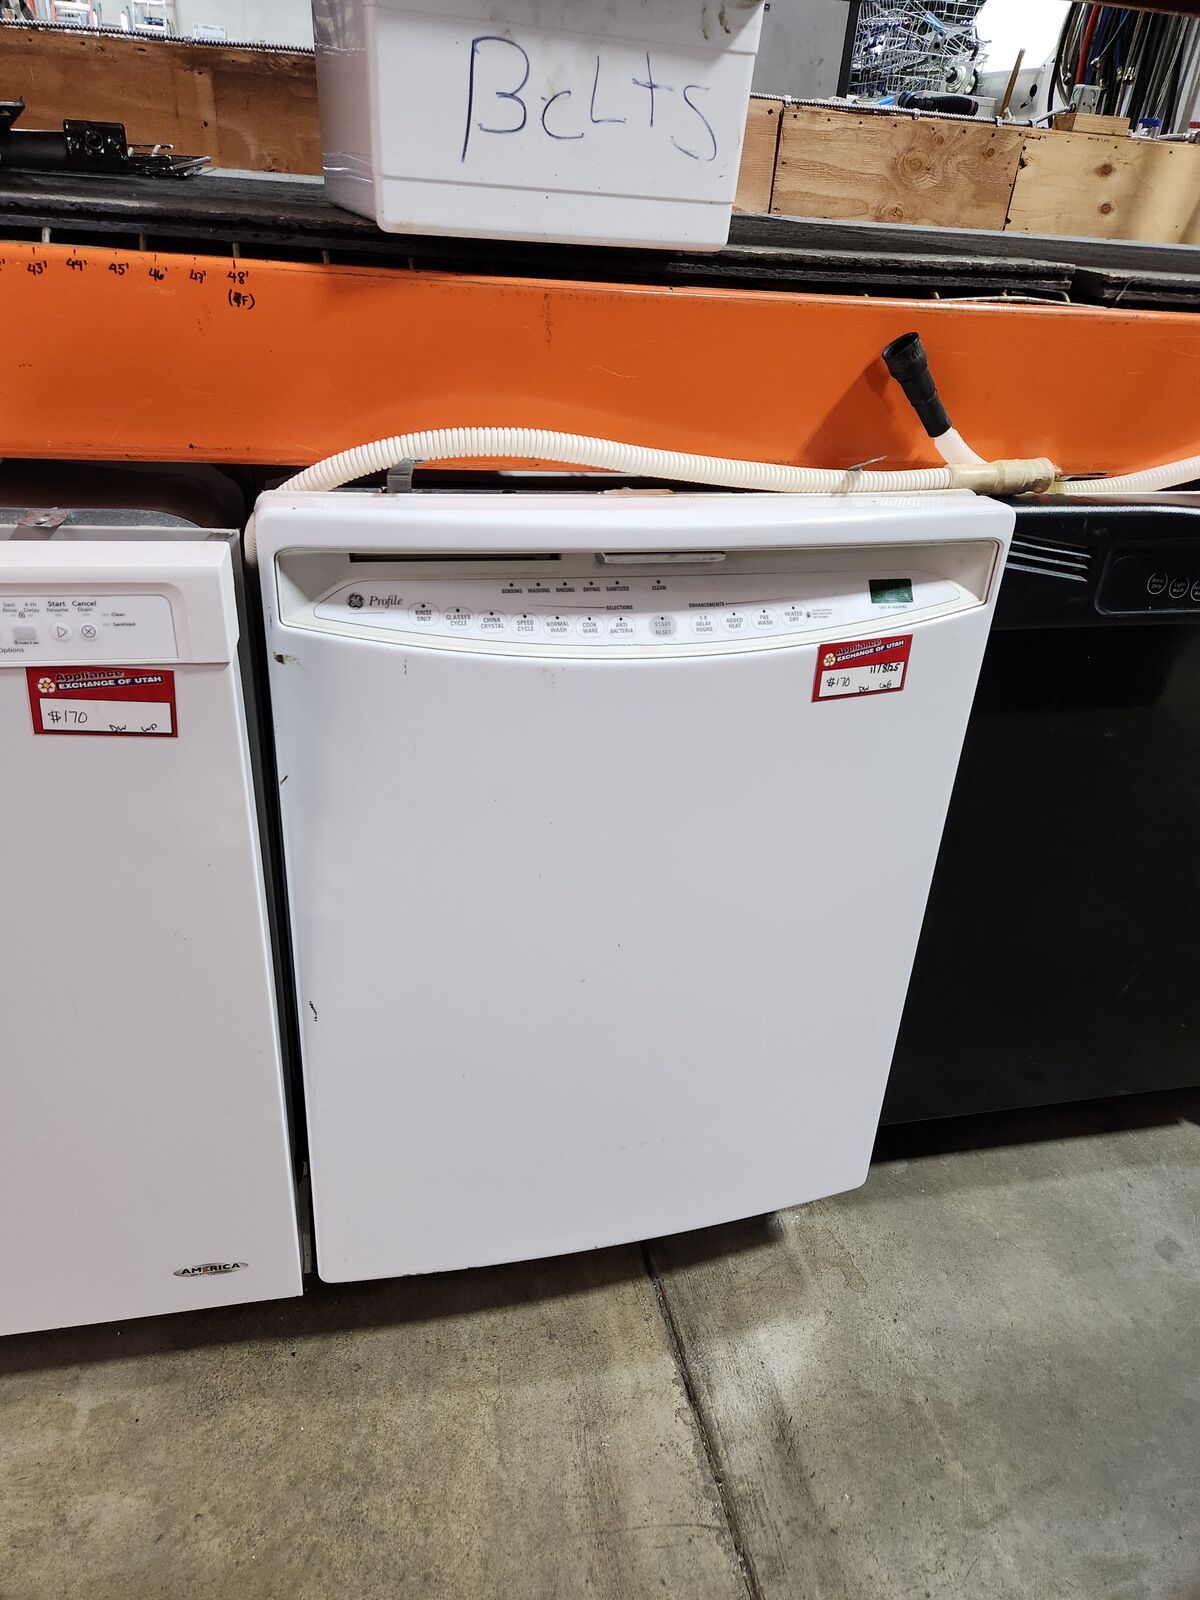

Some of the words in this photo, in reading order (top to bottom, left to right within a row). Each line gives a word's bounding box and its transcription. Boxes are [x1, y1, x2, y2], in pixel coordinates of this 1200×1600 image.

[27, 260, 48, 276] 43'
[66, 258, 87, 271] 44'
[109, 262, 129, 275] 45'
[149, 267, 168, 281] 46'
[227, 271, 248, 284] 48'
[369, 595, 403, 609] Profile
[836, 639, 882, 656] Appliance
[837, 648, 874, 662] EXCHANGE
[886, 640, 904, 649] UTAH
[56, 670, 124, 682] Appliance
[59, 679, 115, 690] EXCHANGE
[134, 676, 162, 684] UTAH
[48, 710, 88, 724] $170
[109, 724, 127, 732] DW
[181, 1262, 241, 1275] AMERICA
